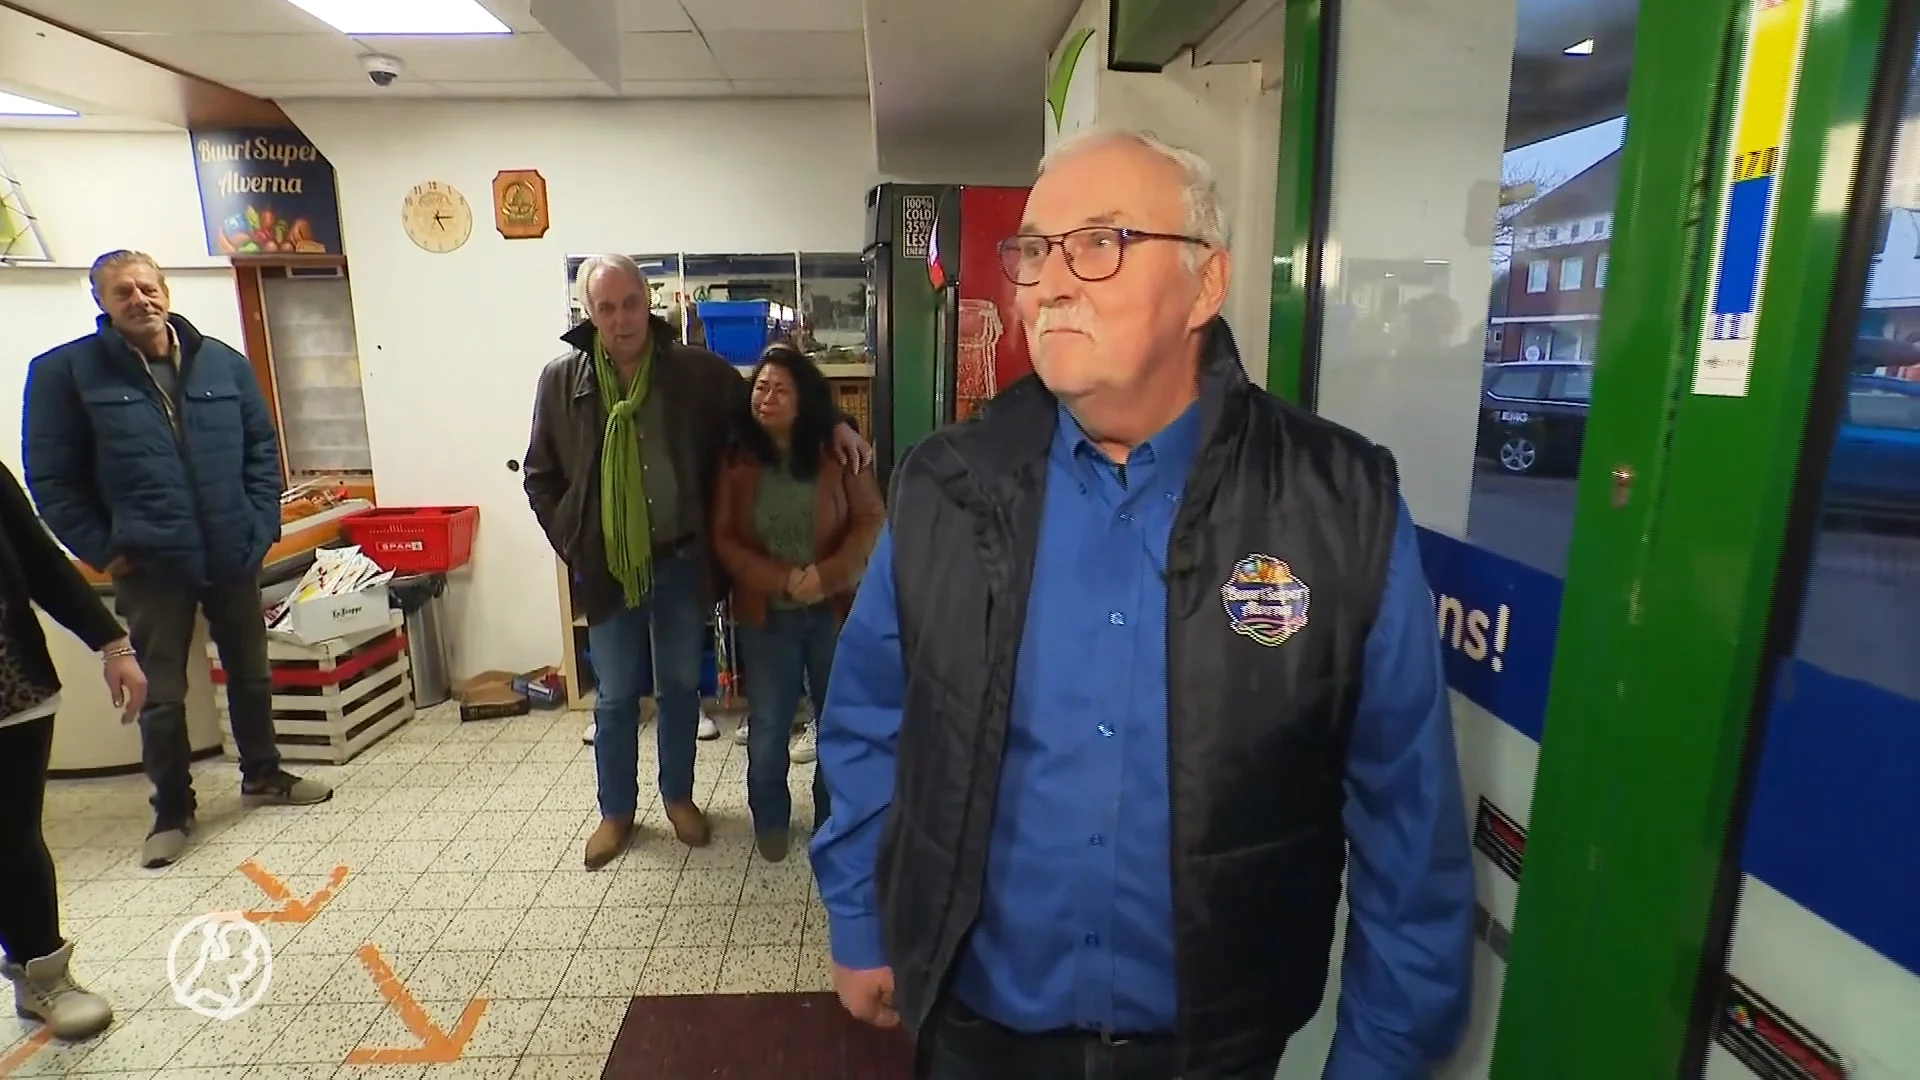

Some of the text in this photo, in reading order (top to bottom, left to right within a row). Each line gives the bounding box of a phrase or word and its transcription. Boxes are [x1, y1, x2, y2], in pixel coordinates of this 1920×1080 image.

[198, 136, 317, 168] Buurt Super
[1733, 146, 1779, 180] 170
[218, 170, 303, 197] Alverna
[428, 181, 437, 190] 12
[905, 198, 932, 209] 100%
[905, 209, 932, 221] COLD
[905, 220, 932, 233] 35%
[1428, 588, 1511, 673] ns!
